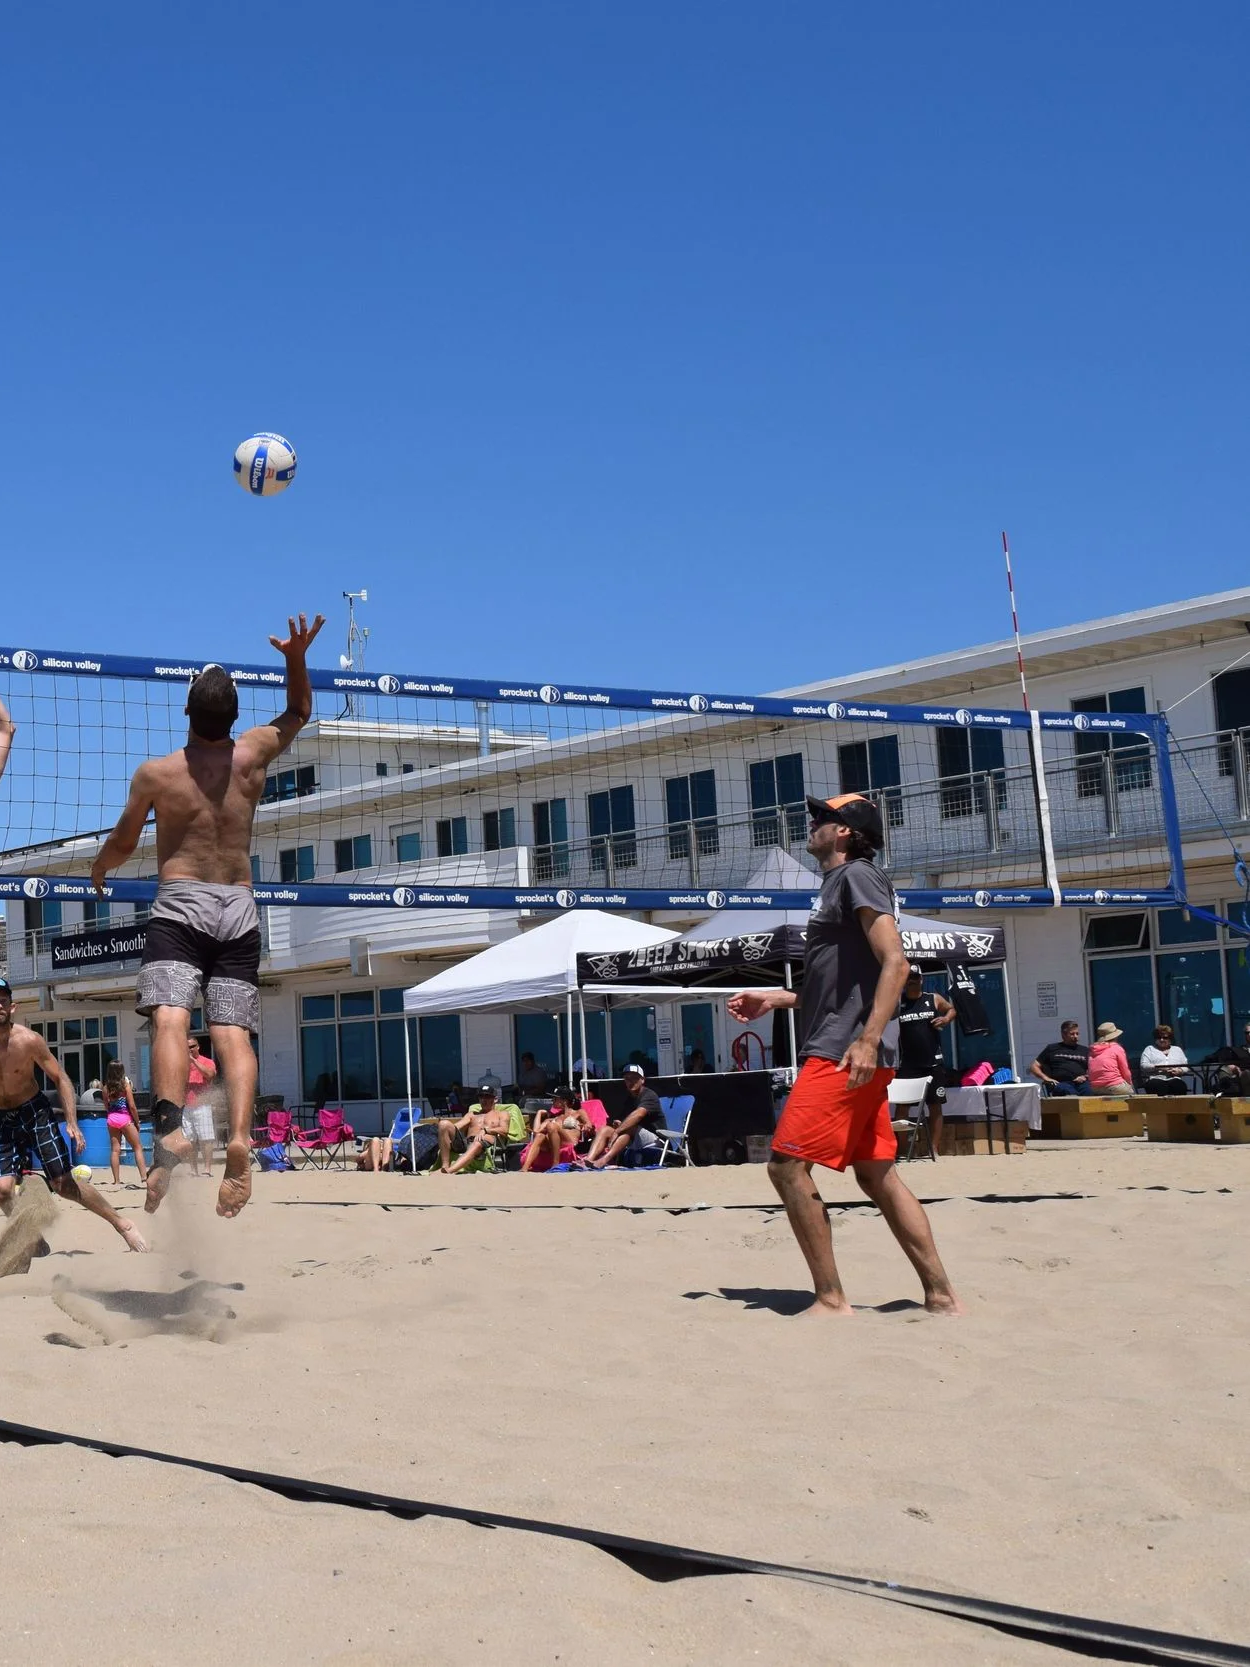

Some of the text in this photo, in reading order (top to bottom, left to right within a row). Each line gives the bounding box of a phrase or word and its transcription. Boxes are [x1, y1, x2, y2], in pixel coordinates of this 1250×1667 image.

[43, 658, 72, 668] silicon
[75, 661, 101, 671] volley
[231, 671, 258, 680] silicon
[260, 673, 284, 683] volley
[334, 679, 453, 693] sprocket's silicon volley
[499, 689, 609, 703] sprocket's silicon volley
[54, 884, 84, 893] silicon
[86, 886, 114, 896] voey
[253, 889, 298, 900] icon volley
[349, 892, 469, 903] sprocket's silicon volley
[515, 894, 554, 903] sprocket's
[605, 895, 626, 904] volley
[54, 933, 147, 961] Sandwiches Smoothi
[901, 931, 956, 950] SPORTS
[677, 937, 733, 962] SPORTS
